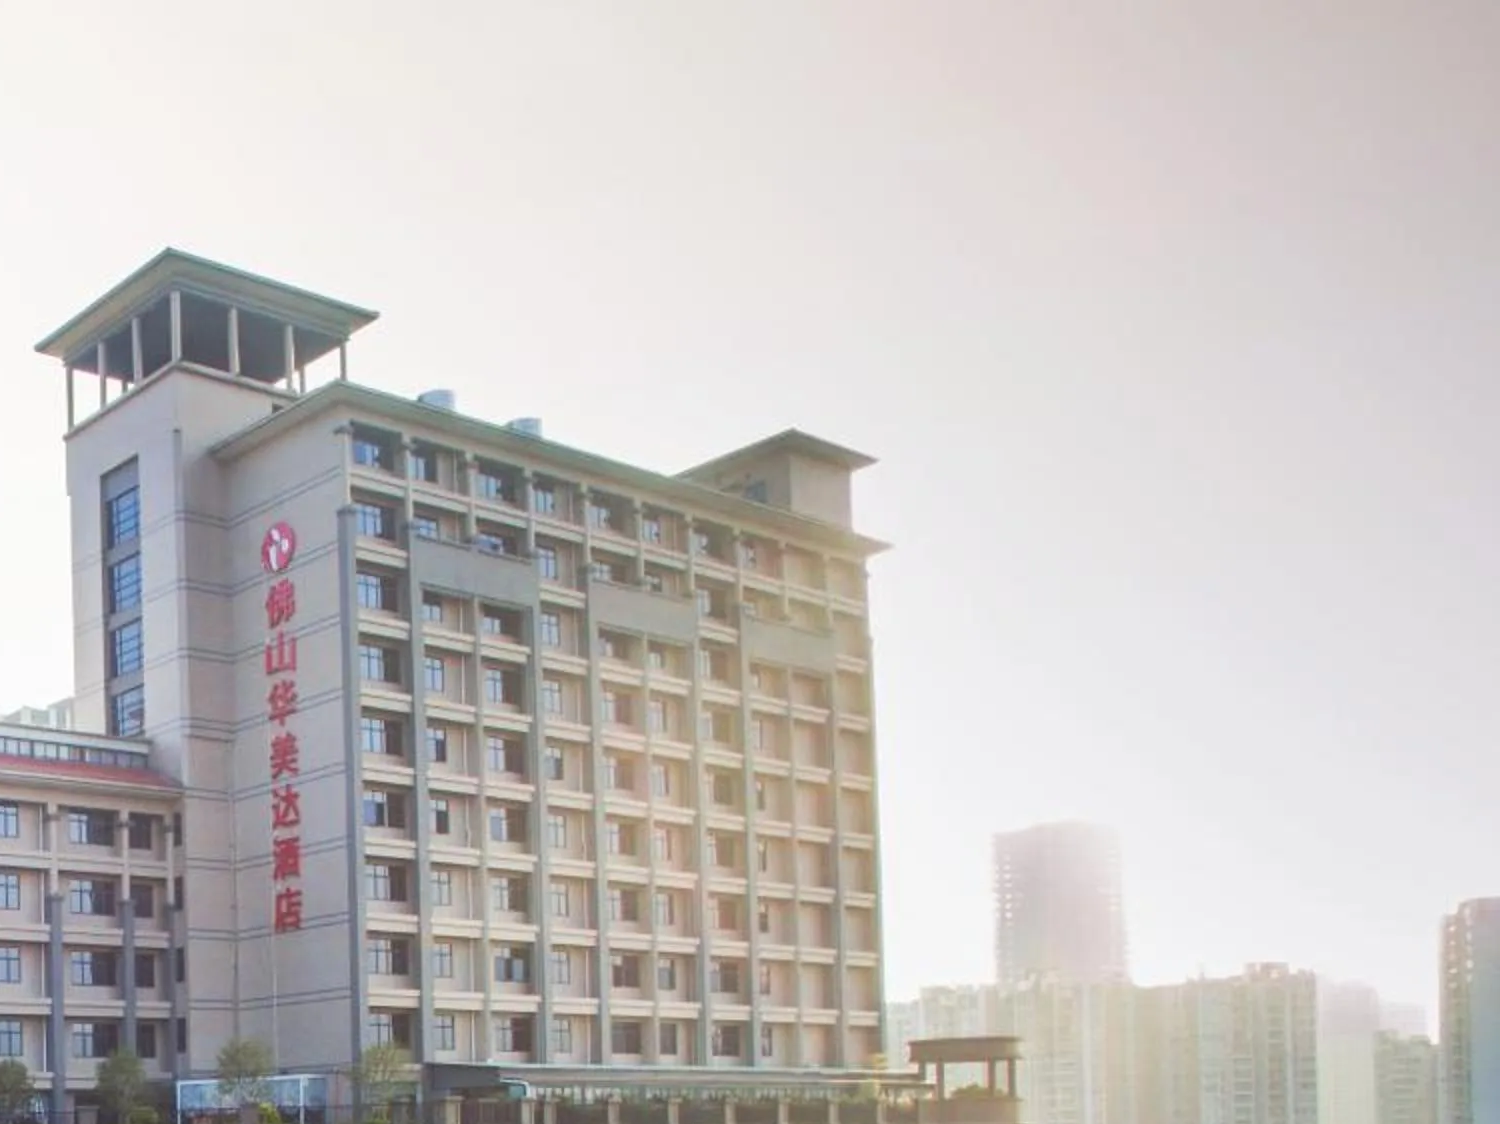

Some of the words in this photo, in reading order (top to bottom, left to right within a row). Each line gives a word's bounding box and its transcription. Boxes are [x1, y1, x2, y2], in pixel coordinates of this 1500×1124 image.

[264, 577, 303, 933] 佛山华美达酒店
